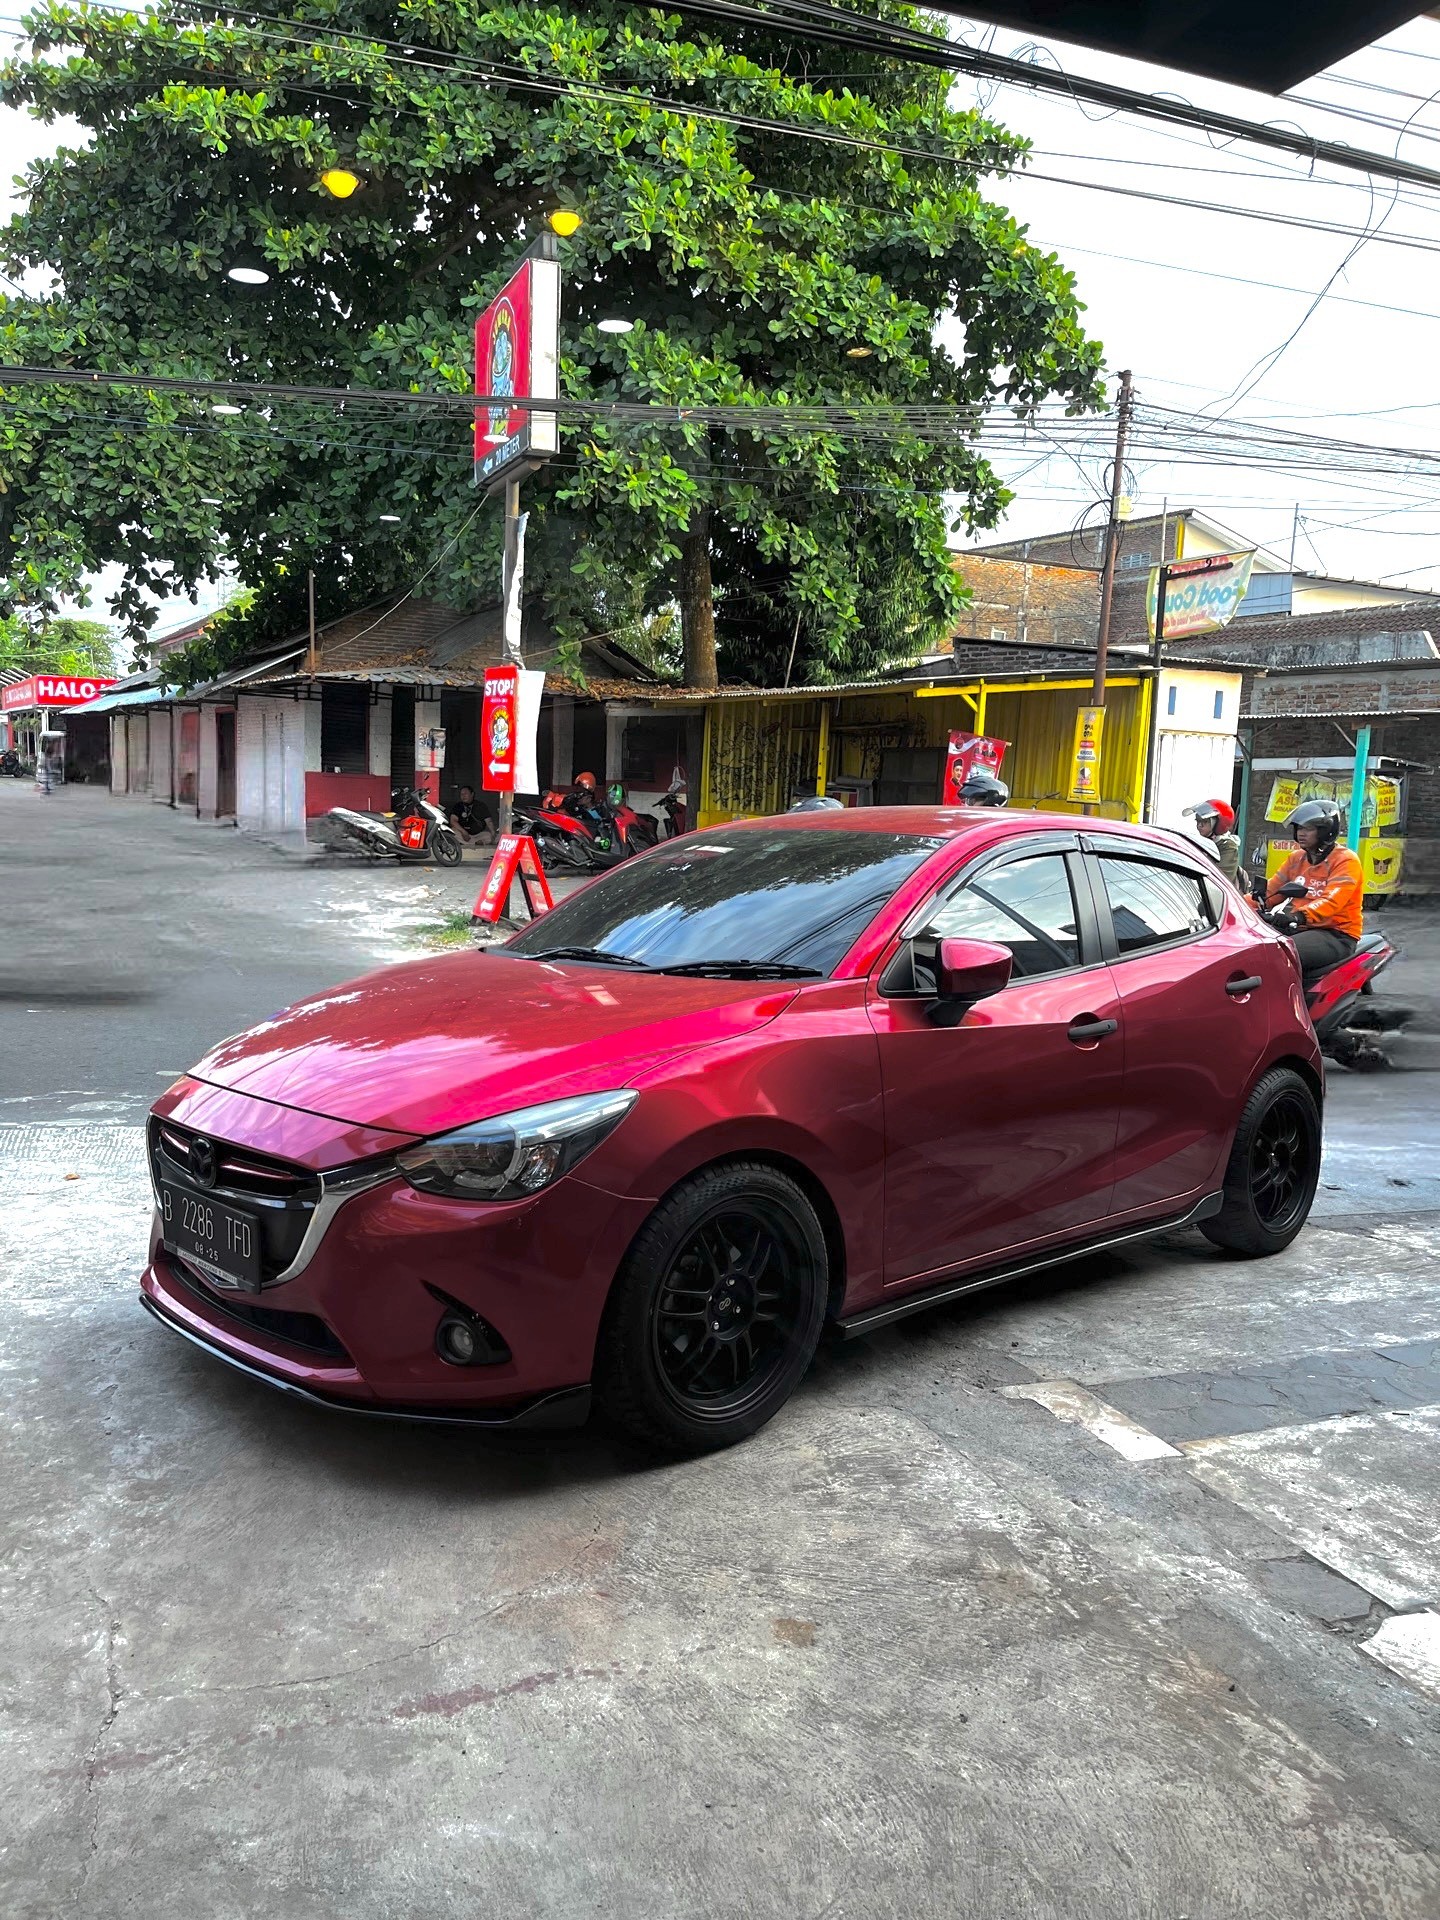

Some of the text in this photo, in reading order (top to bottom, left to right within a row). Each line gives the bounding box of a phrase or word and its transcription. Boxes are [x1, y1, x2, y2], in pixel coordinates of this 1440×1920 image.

[38, 680, 96, 699] HALO
[485, 678, 515, 696] STOP!
[1378, 797, 1396, 806] ASLI
[498, 838, 518, 853] STOP!
[163, 1189, 251, 1259] B 2286 TFD
